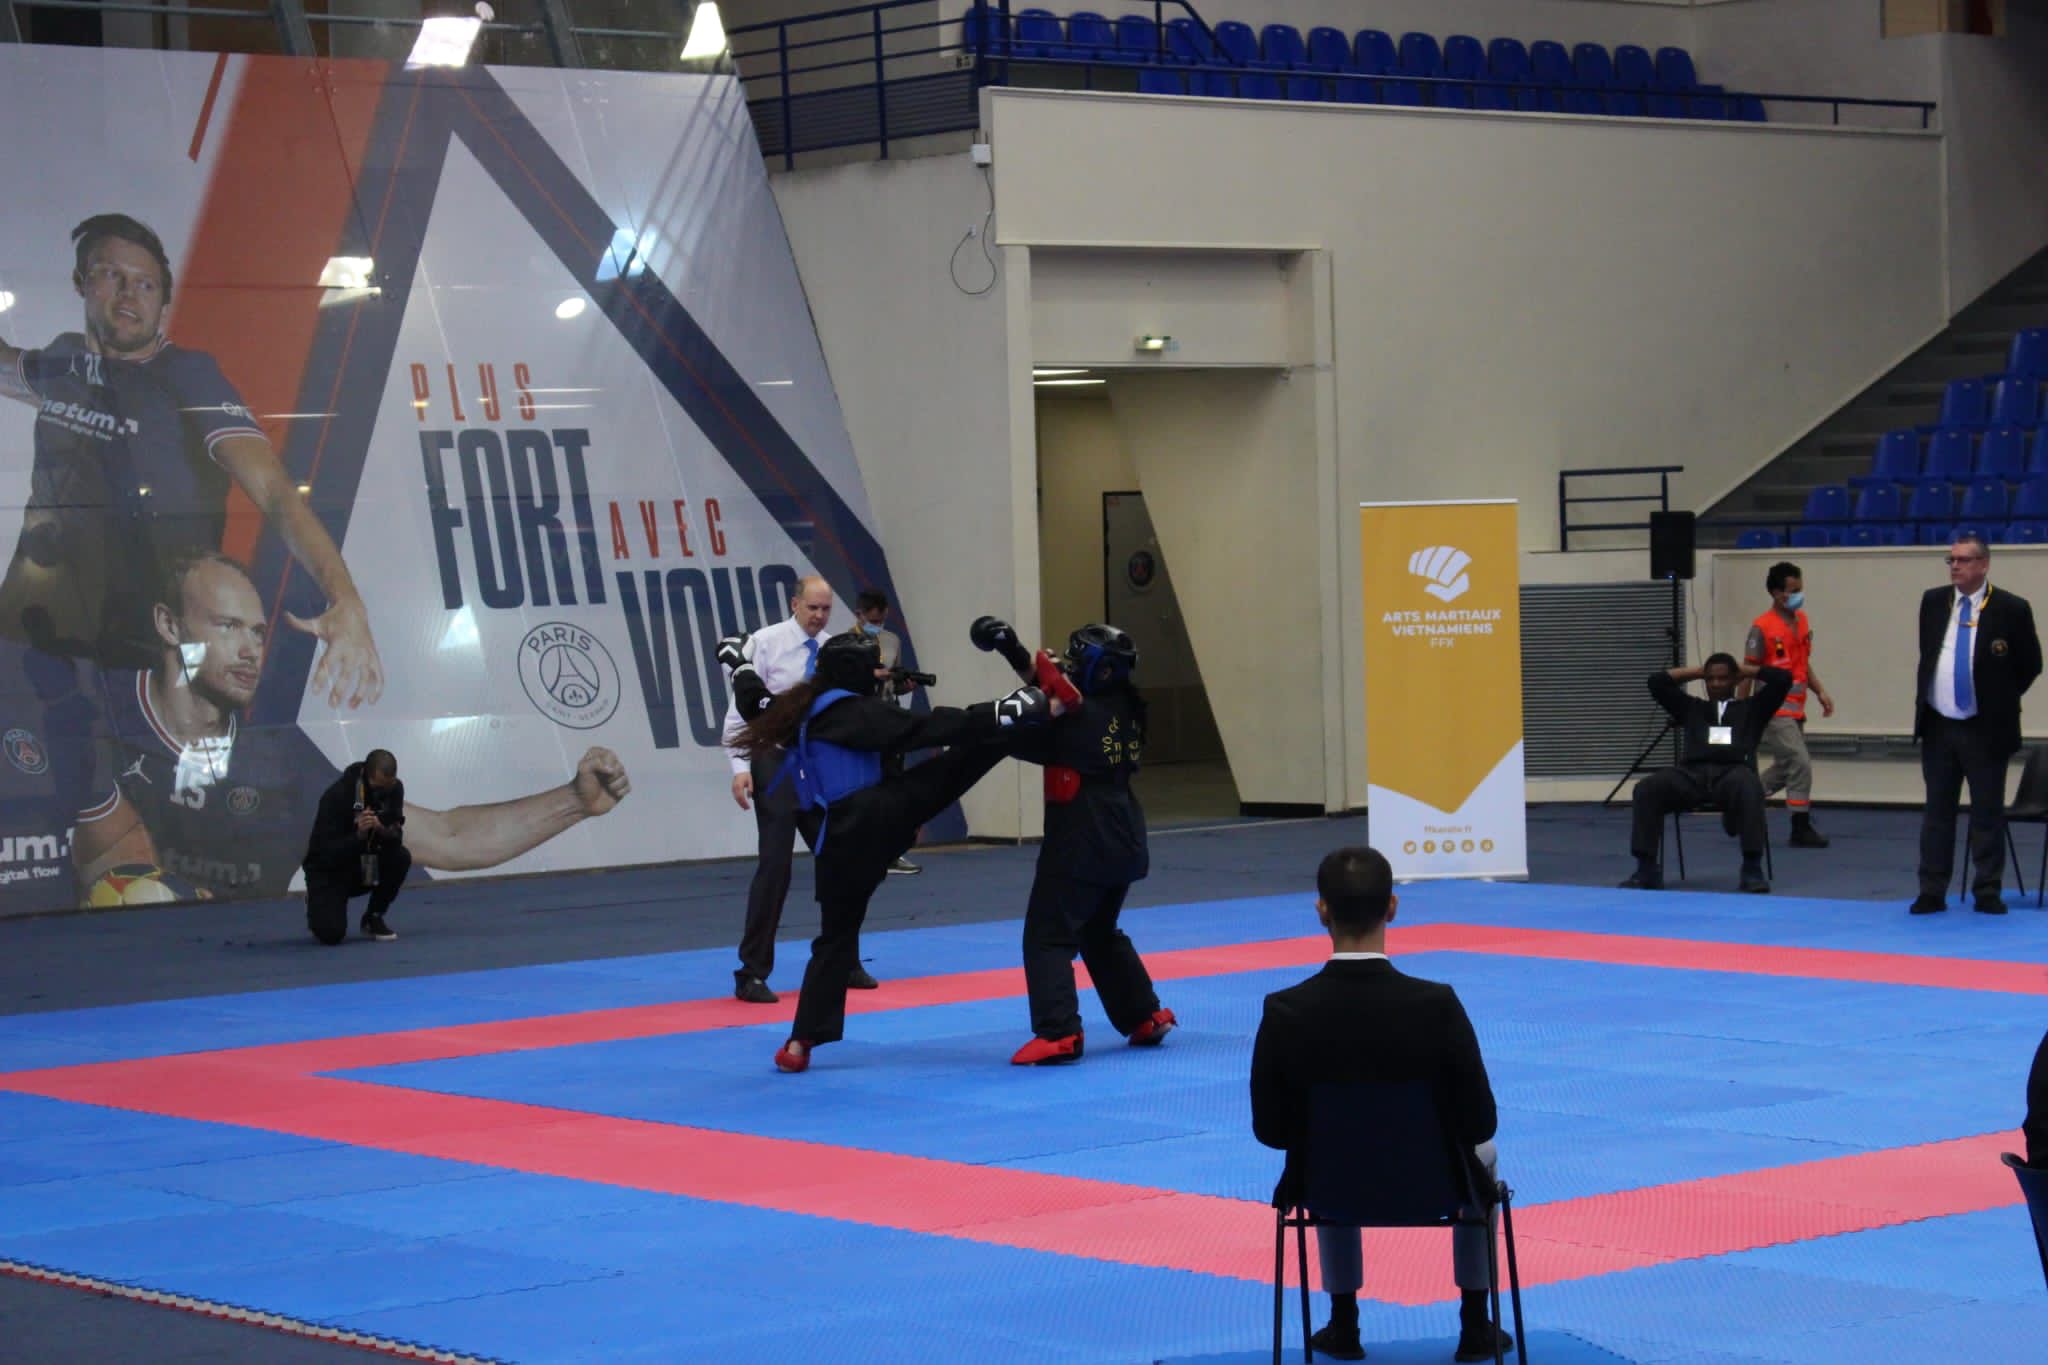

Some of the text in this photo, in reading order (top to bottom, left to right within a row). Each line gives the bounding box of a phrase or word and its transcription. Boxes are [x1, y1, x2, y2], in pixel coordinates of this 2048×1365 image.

[410, 363, 536, 422] PLUS
[419, 428, 607, 610] FORT
[609, 498, 727, 558] AVEC
[1383, 608, 1501, 622] ARTS MARTIAUX
[1392, 623, 1493, 636] VIETNAMIENS
[528, 627, 591, 653] PARIS
